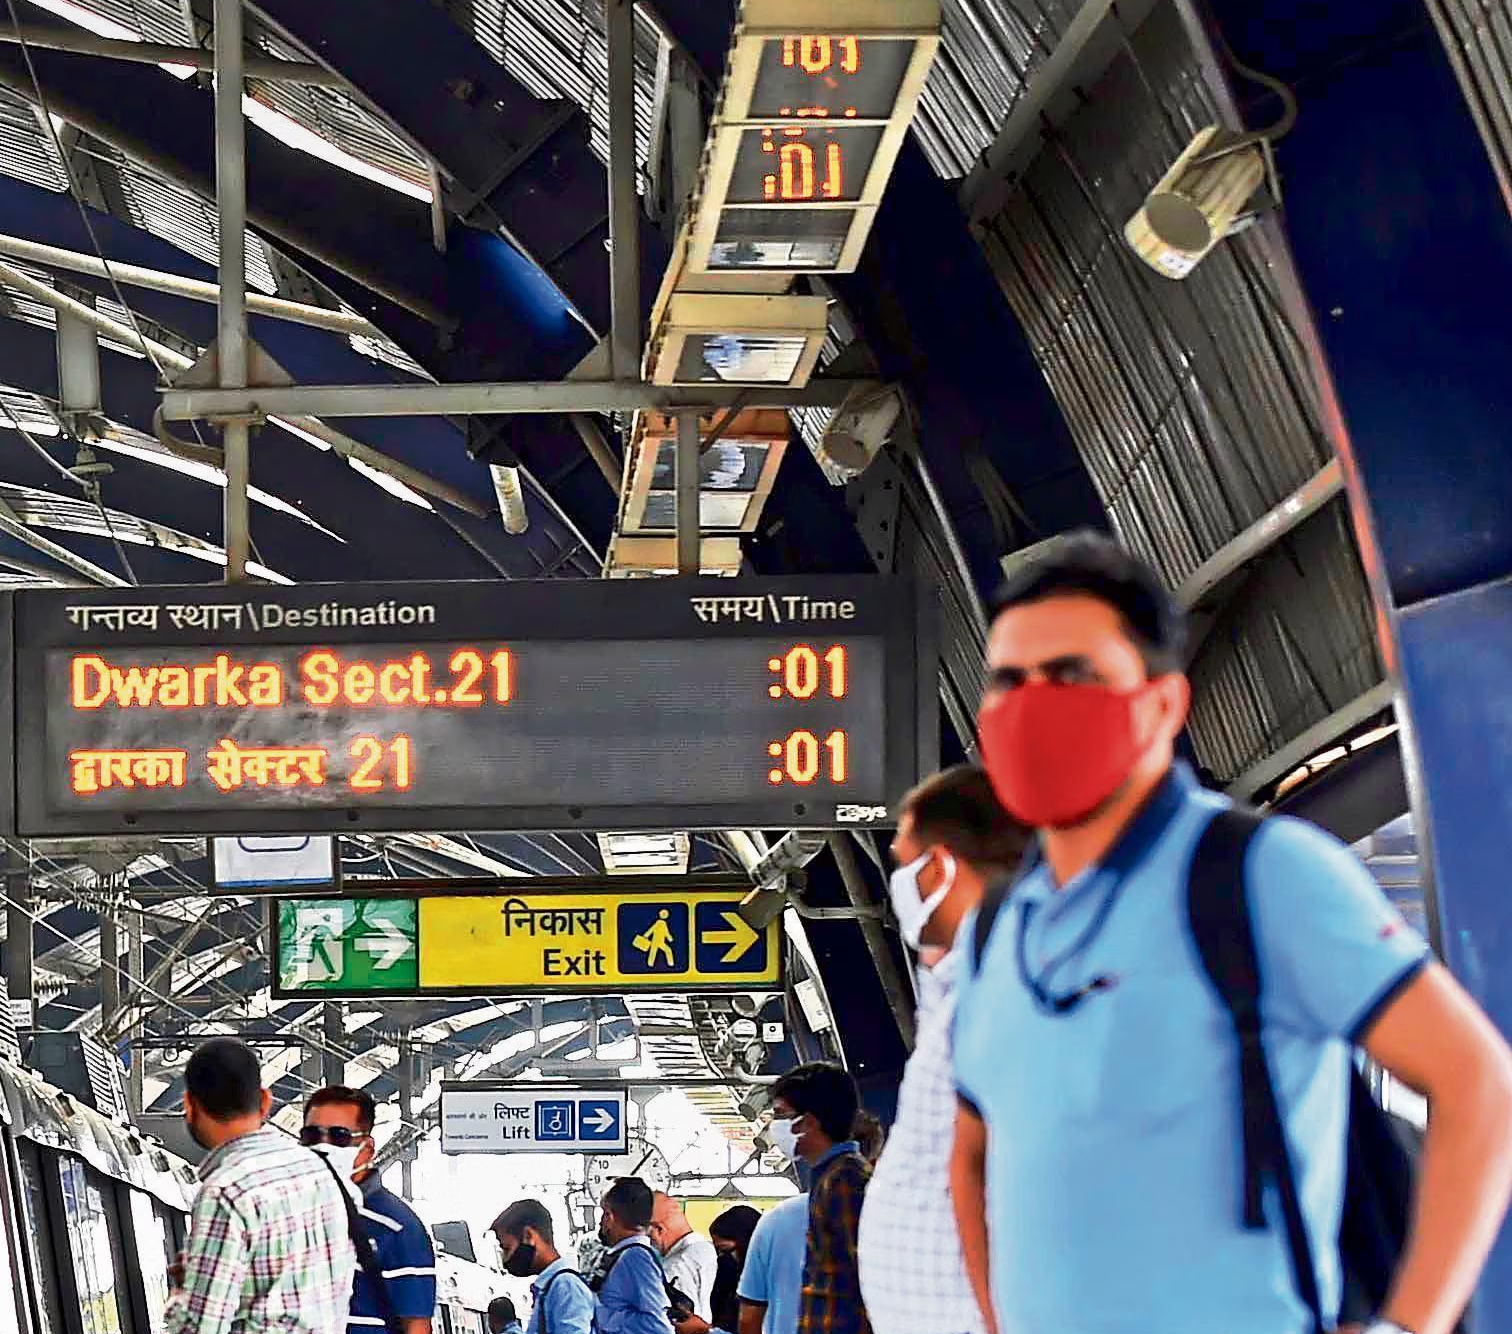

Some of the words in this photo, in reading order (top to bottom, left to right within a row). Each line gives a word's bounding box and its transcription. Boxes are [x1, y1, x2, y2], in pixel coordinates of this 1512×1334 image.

[66, 603, 158, 632] गन्तव्य
[71, 653, 283, 708] Dwarka
[301, 648, 512, 706] Sect.21
[767, 645, 848, 699] :01
[206, 738, 329, 791] सेक्टर
[349, 734, 413, 792] 21
[767, 729, 848, 784] :01
[501, 899, 607, 937] निकास
[543, 948, 607, 977] Exit
[493, 1102, 530, 1121] लिफ्ट
[502, 1126, 530, 1140] Lift
